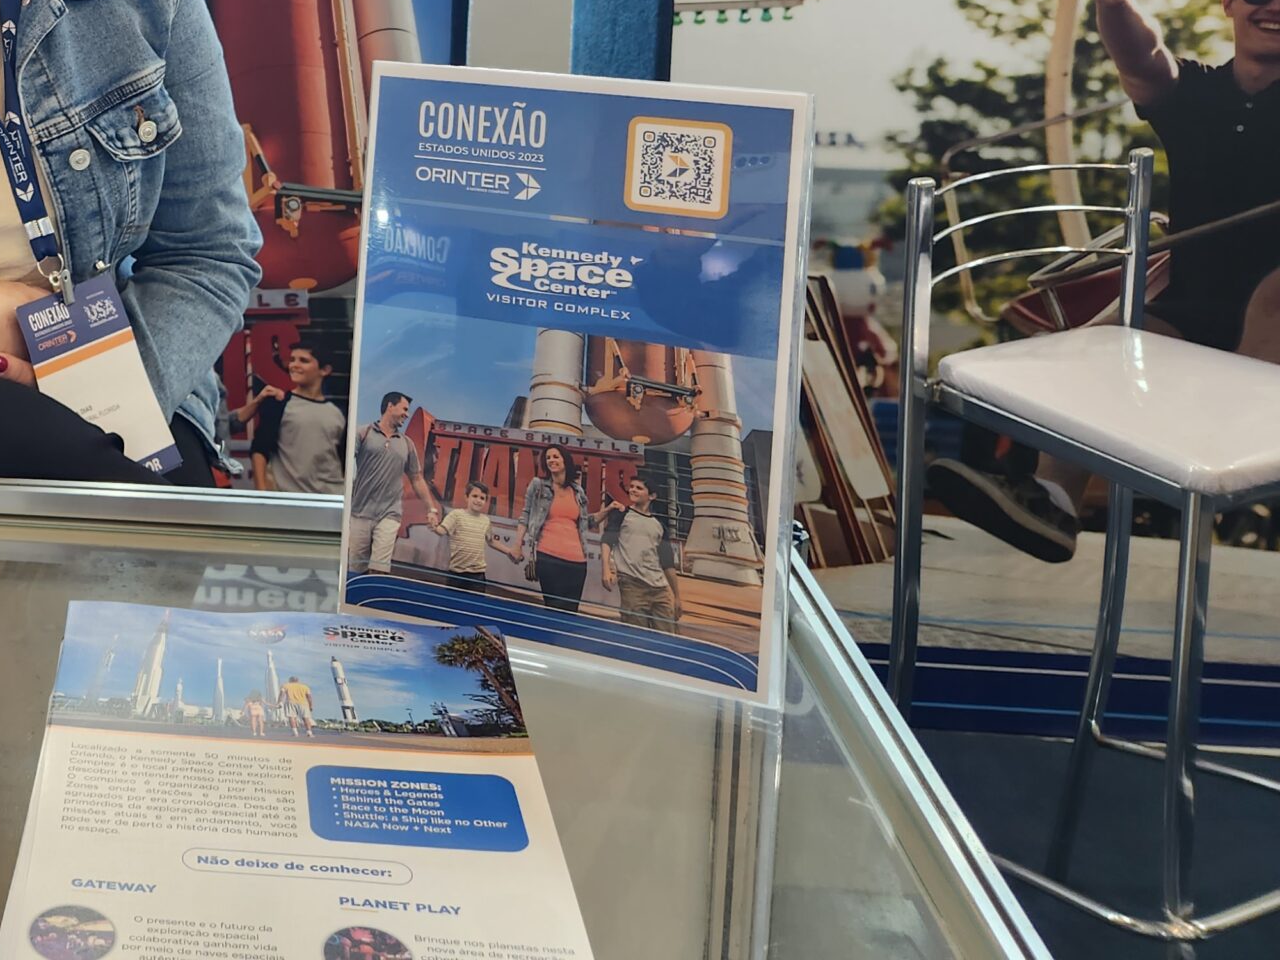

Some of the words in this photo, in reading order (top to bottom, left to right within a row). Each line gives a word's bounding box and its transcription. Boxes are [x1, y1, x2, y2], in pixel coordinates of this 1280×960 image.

[419, 101, 547, 148] CONEXÃO
[418, 142, 469, 155] ESTADOS
[471, 148, 516, 160] UNIDOS
[517, 152, 544, 163] 2023
[415, 166, 510, 190] ORINTER
[522, 242, 622, 268] Kennedy
[490, 247, 633, 288] Space
[534, 278, 611, 299] Center
[486, 292, 548, 309] VISITOR
[554, 302, 631, 320] COMPLEX
[28, 302, 69, 332] CONEXÃO
[438, 422, 510, 438] SPACE
[525, 432, 639, 454] SHUTTLE
[330, 777, 388, 789] MISSION
[391, 780, 442, 791] ZONES:
[340, 787, 380, 796] Heroes
[395, 790, 444, 800] Legends
[341, 795, 382, 804] Behind
[385, 798, 406, 806] the
[409, 799, 441, 808] Gates
[342, 803, 370, 812] Race
[374, 805, 386, 813] to
[390, 806, 409, 814] the
[411, 808, 445, 817] Moon
[343, 811, 388, 822] Shuttle:
[402, 816, 428, 825] Ship
[431, 816, 452, 825] like
[455, 819, 471, 827] no
[473, 819, 508, 829] Other
[344, 820, 379, 830] NASA
[382, 822, 409, 832] Now
[424, 825, 452, 834] Next
[197, 854, 230, 867] Não
[234, 858, 280, 870] deixe
[284, 860, 305, 872] de
[310, 863, 393, 878] conhecer:
[71, 877, 157, 894] GATEWAY
[339, 896, 410, 912] PLANET
[416, 903, 461, 916] PLAY
[146, 917, 196, 928] presente
[220, 922, 255, 932] futuro
[129, 934, 199, 947] colaborativa
[203, 941, 250, 951] ganham
[253, 943, 278, 952] vida
[213, 932, 259, 941] espacial
